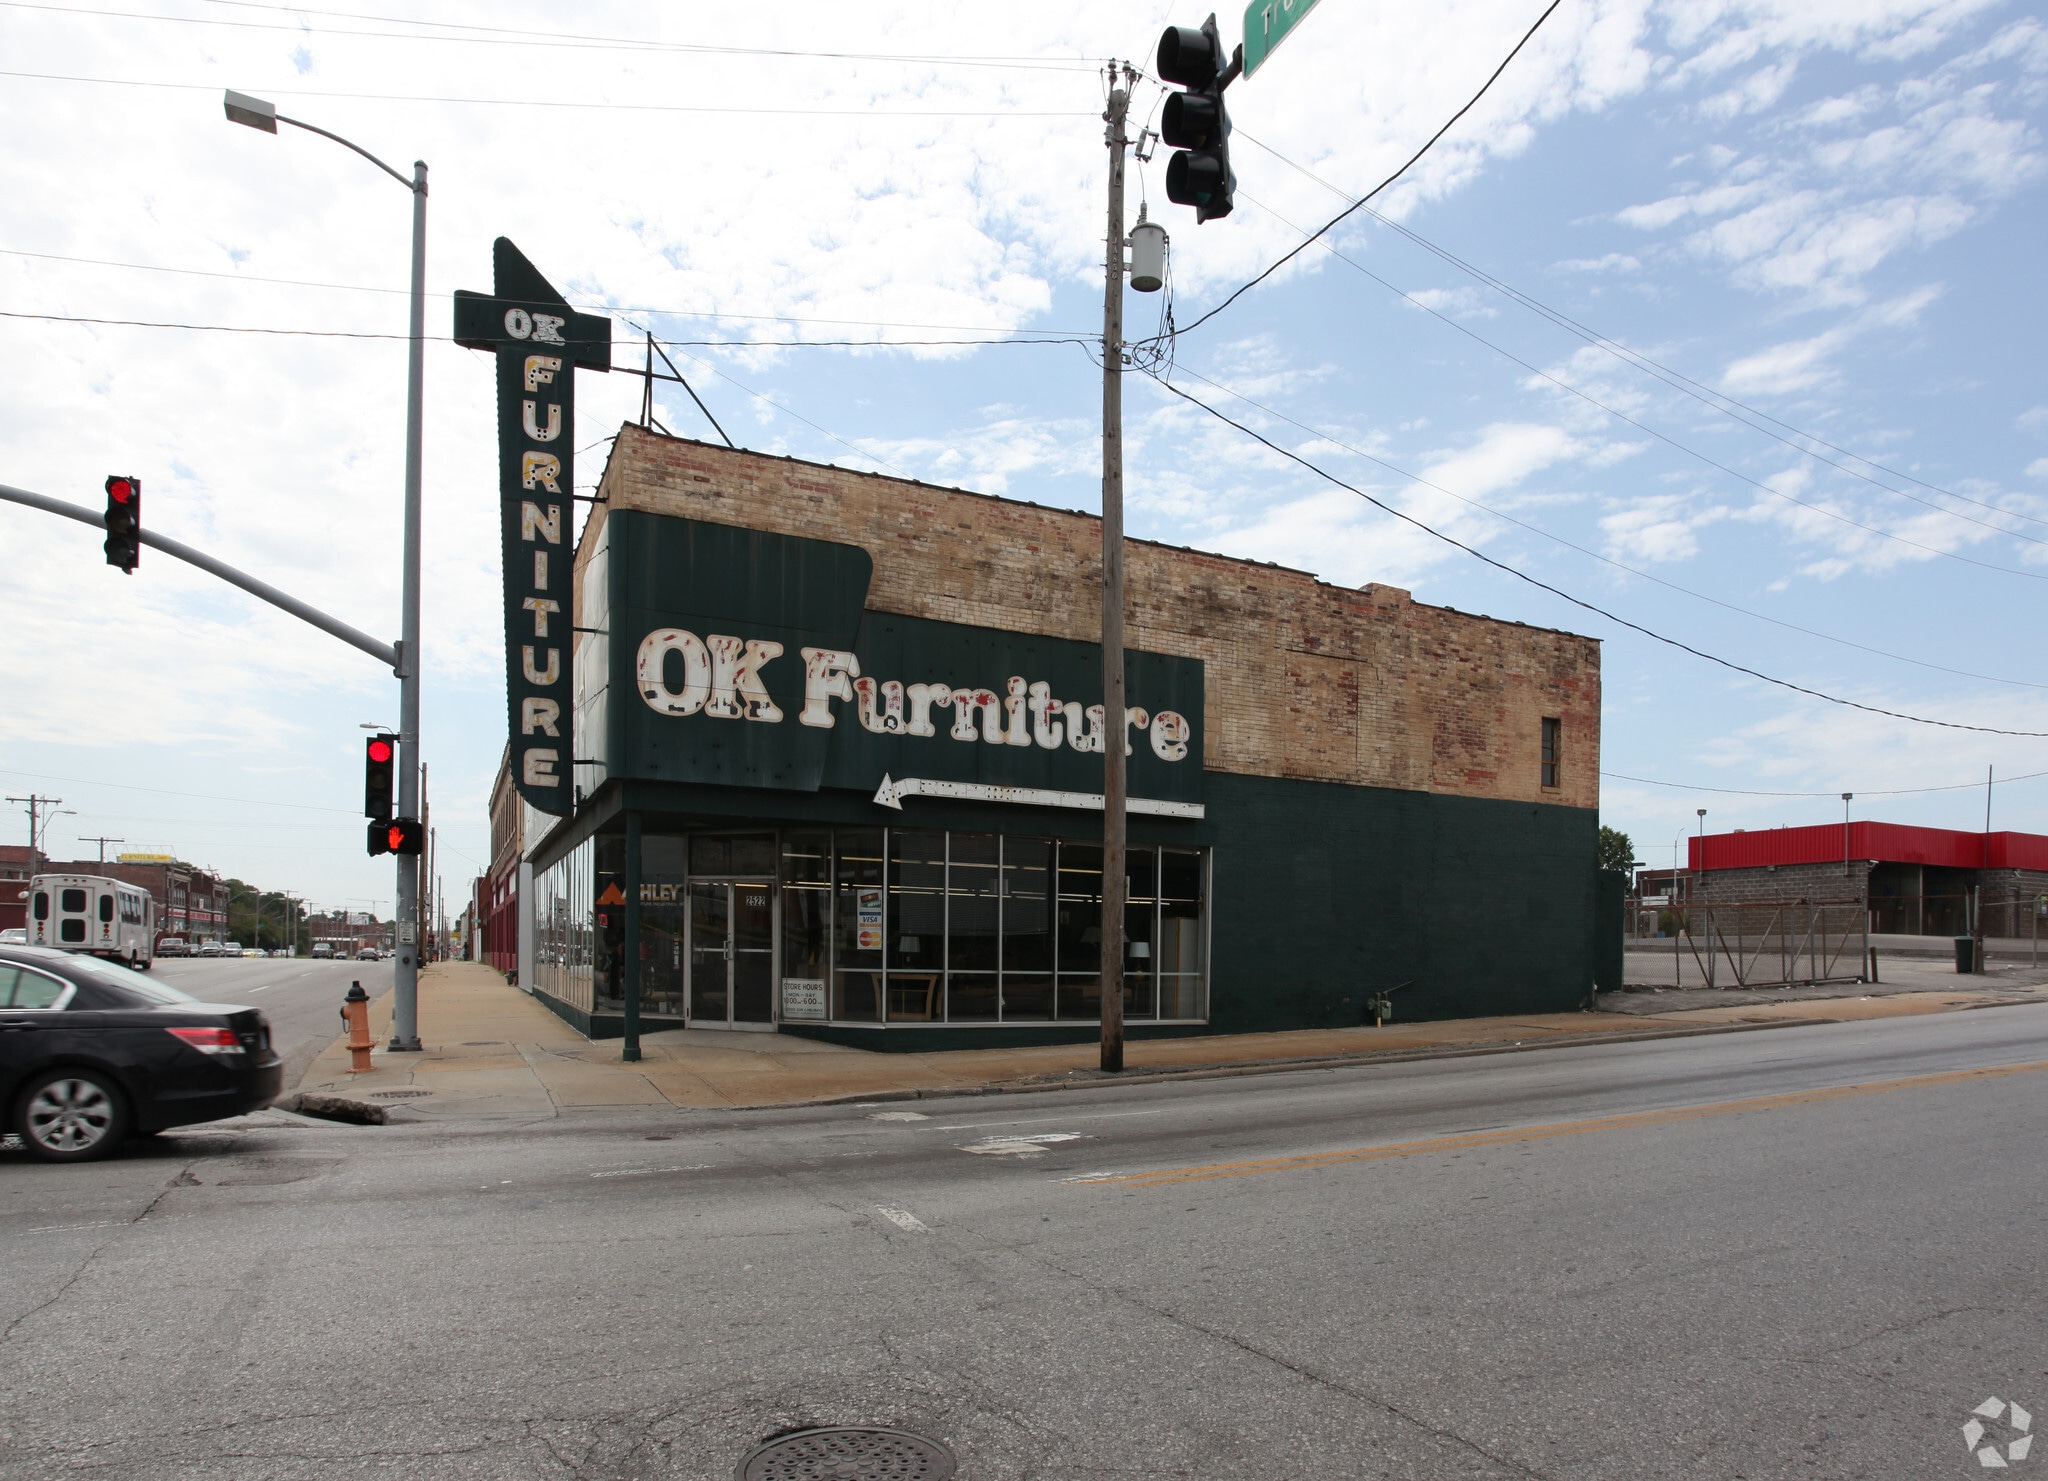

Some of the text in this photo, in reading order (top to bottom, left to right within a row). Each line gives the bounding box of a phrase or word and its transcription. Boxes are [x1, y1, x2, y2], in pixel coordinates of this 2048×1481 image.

[504, 307, 566, 347] OK
[521, 354, 562, 788] FURNITURE
[636, 628, 784, 722] OK
[746, 895, 765, 906] 2522
[783, 982, 823, 991] STORE HOURS
